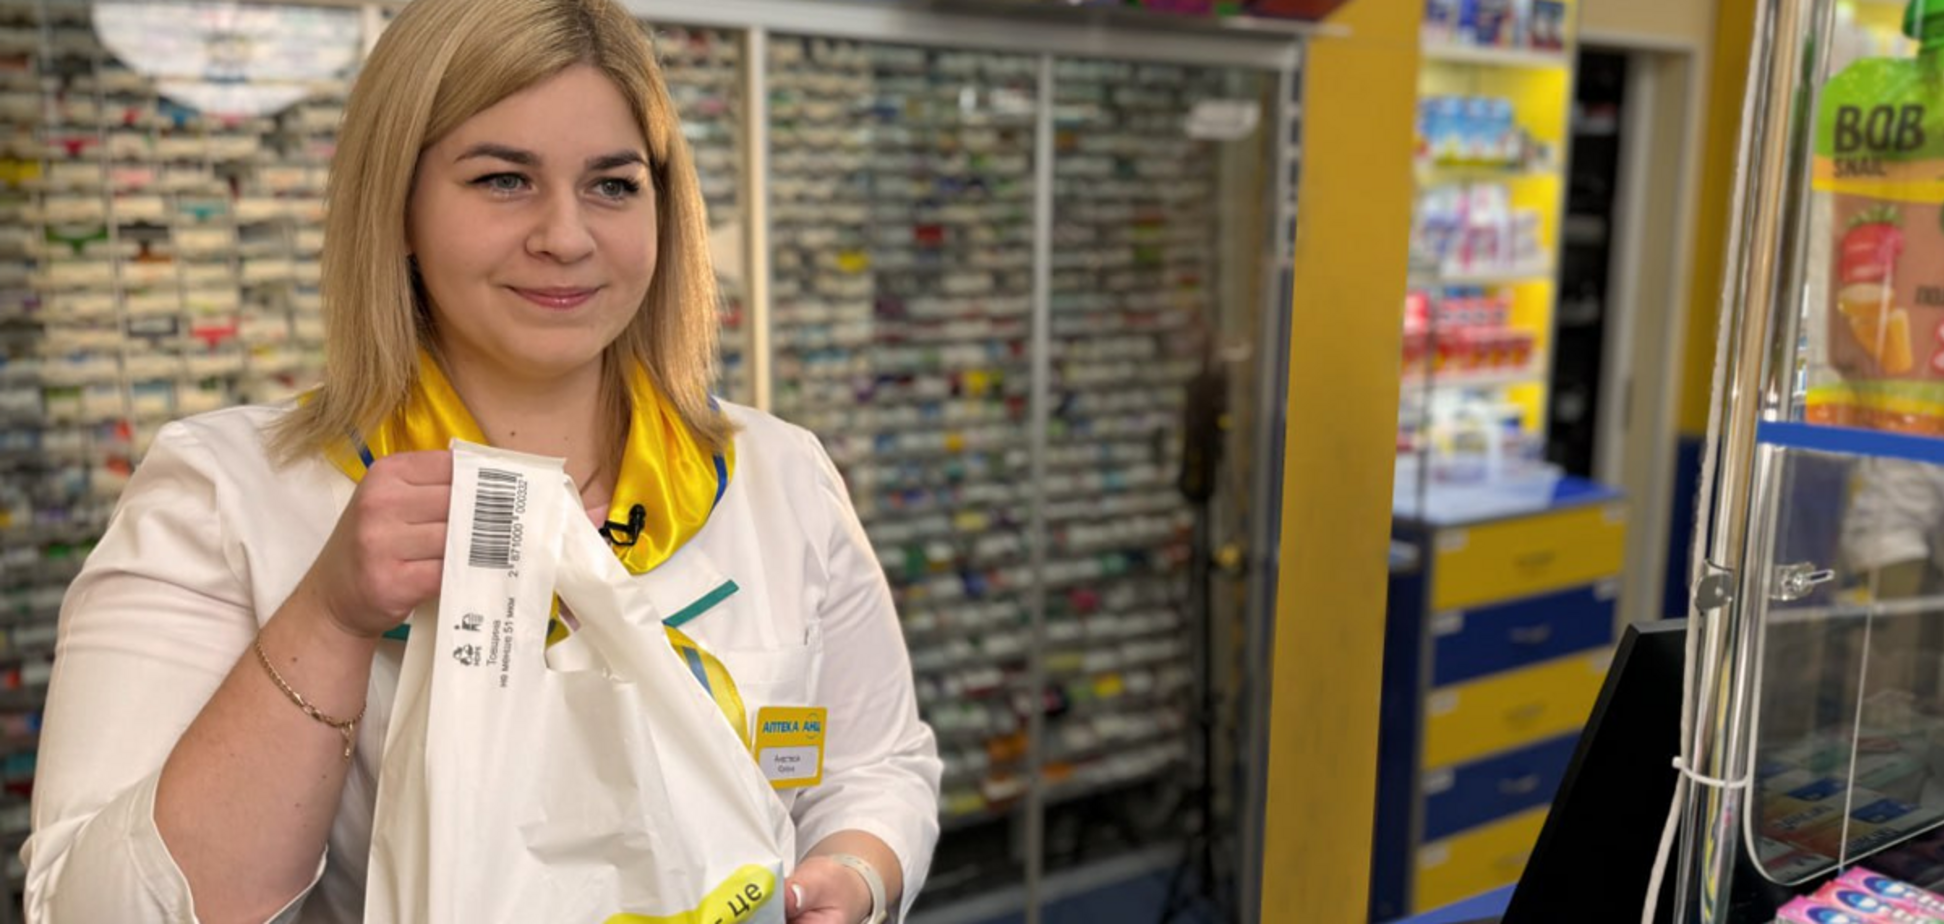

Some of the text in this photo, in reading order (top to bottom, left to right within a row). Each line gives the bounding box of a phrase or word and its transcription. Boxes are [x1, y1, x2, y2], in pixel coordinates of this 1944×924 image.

[1833, 104, 1925, 153] BOB
[1833, 158, 1887, 178] SNAIL
[508, 480, 528, 578] 2 871000 000332
[486, 619, 501, 666] Товщина
[500, 597, 515, 688] не менше 51 мкм
[762, 721, 799, 733] АПТЕКА
[727, 883, 762, 918] це
